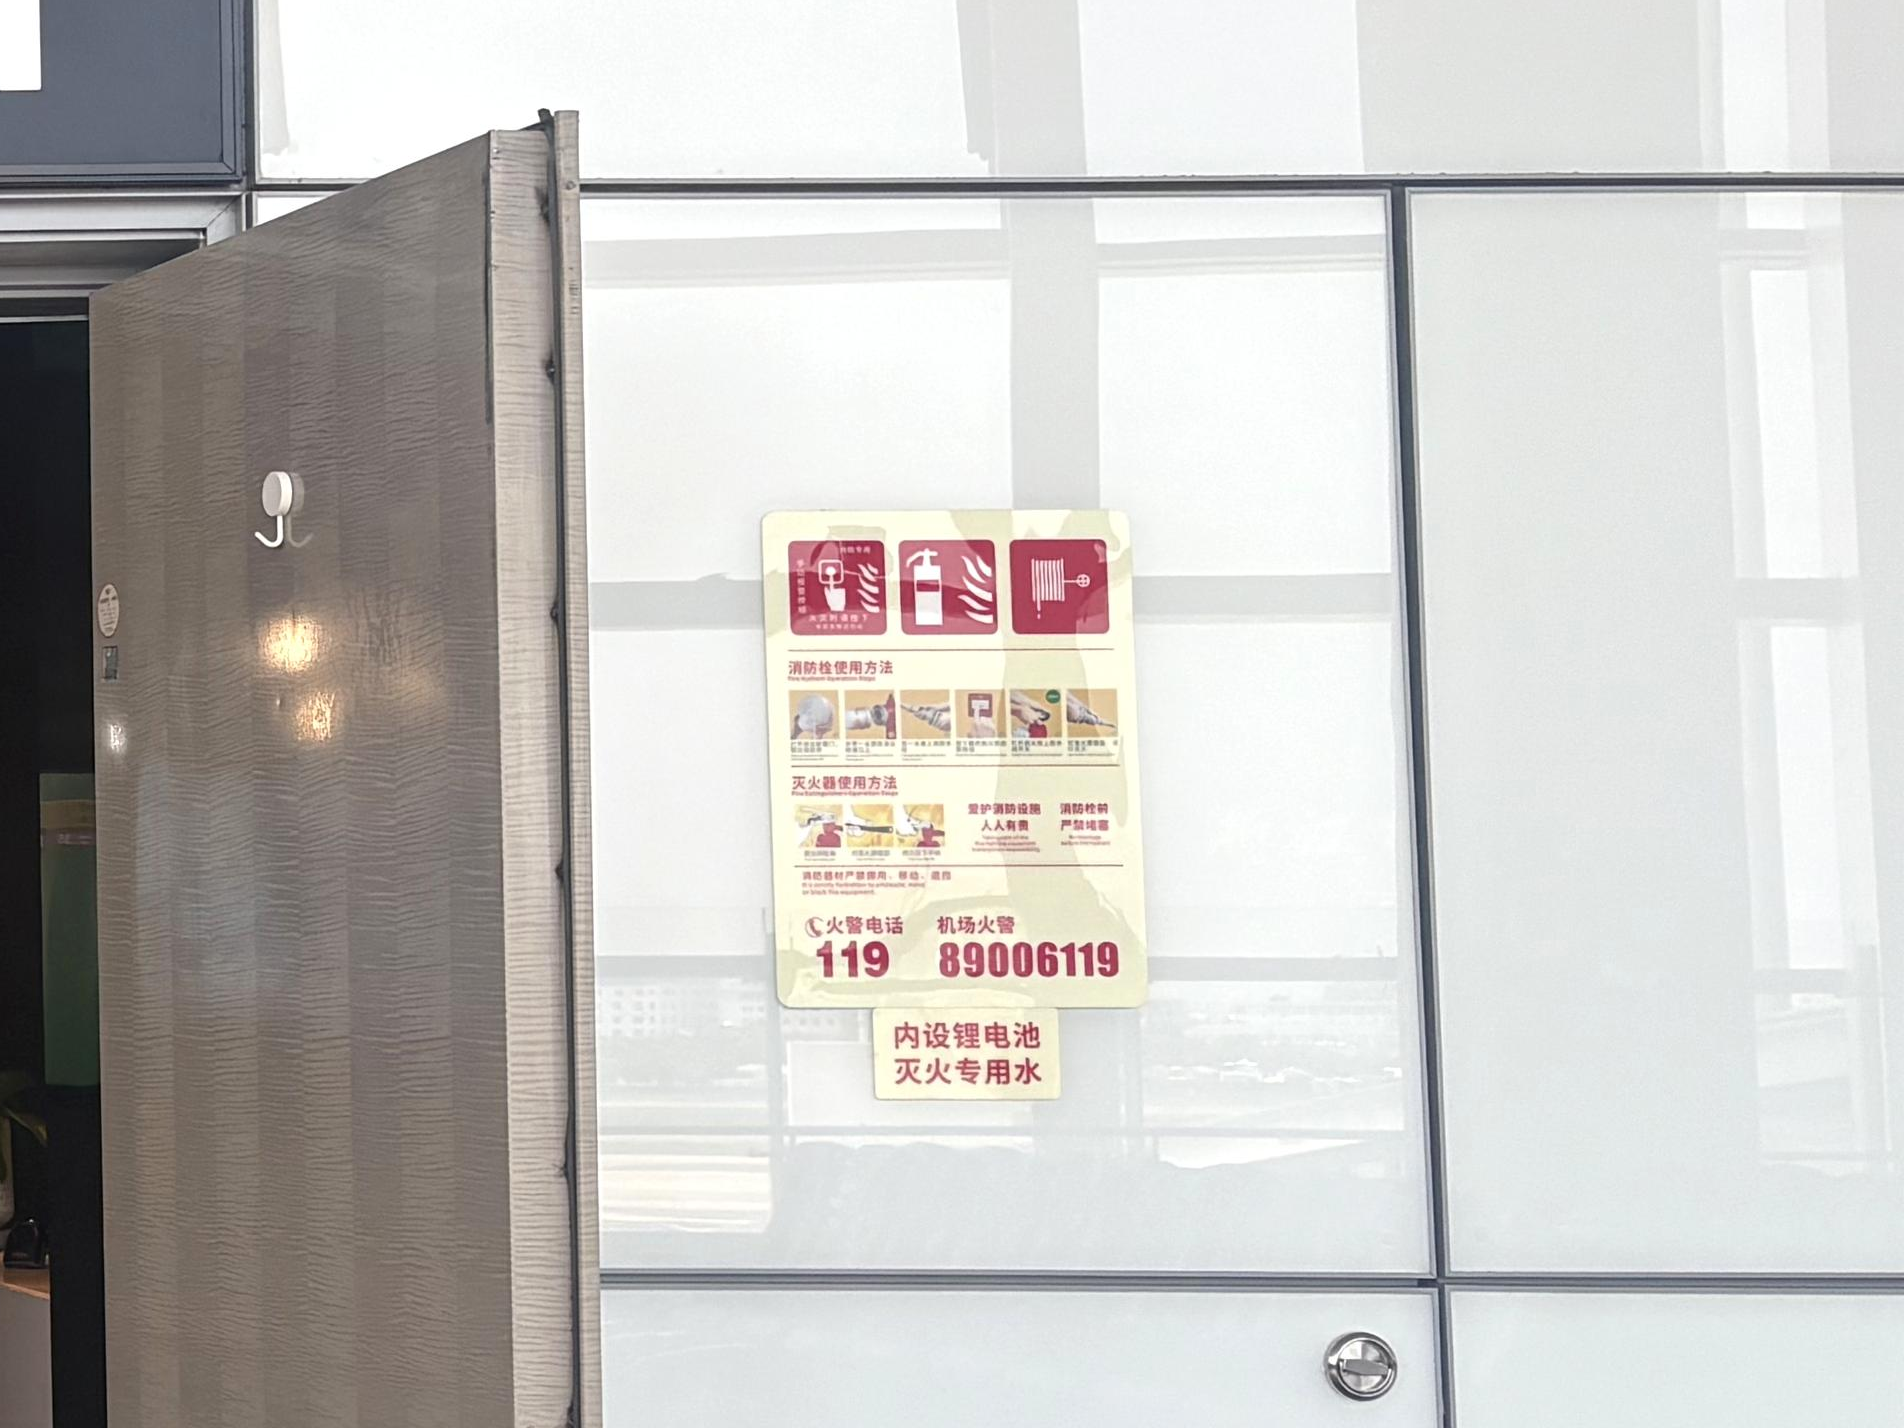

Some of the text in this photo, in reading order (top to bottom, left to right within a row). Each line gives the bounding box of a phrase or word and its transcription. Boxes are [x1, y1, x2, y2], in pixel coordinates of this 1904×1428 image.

[788, 660, 893, 675] 消防栓使用方法
[792, 775, 898, 790] 灭火器使用方法
[826, 916, 1016, 935] 火警电话 机场火警
[816, 941, 1119, 978] 119 89006119
[894, 1022, 1041, 1050] 内设锂电池
[894, 1058, 1042, 1085] 灭火专用水
